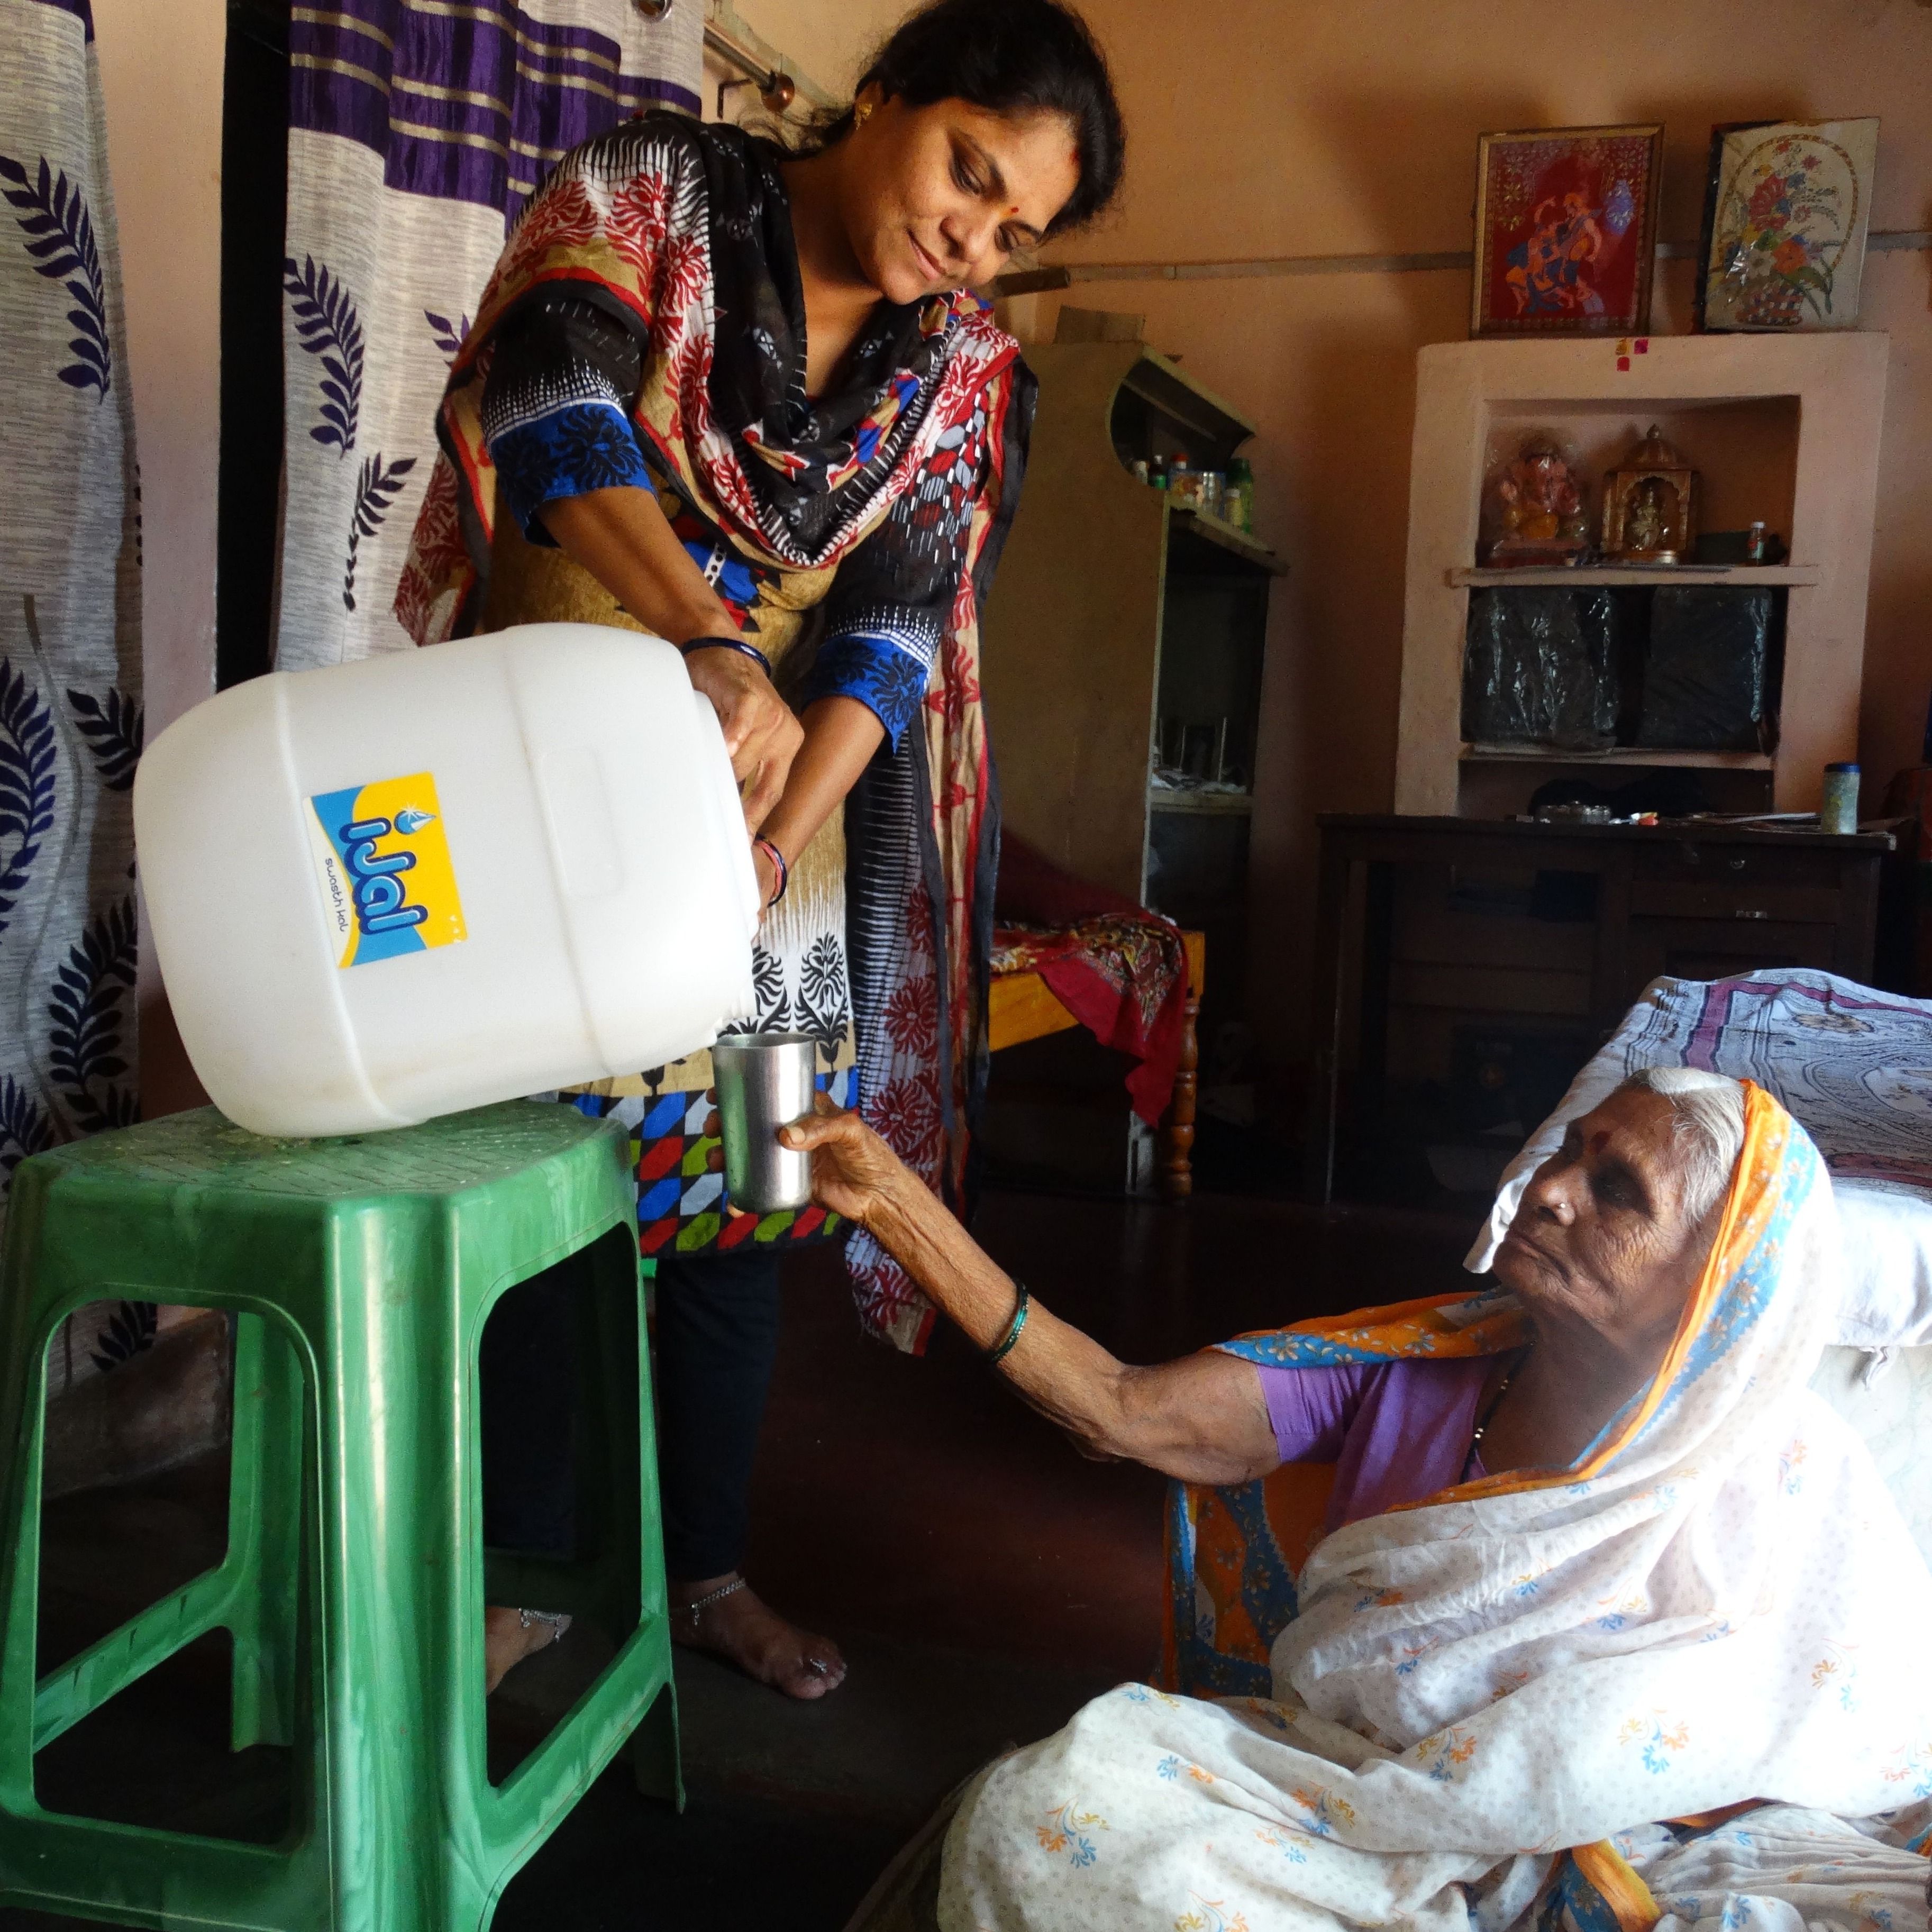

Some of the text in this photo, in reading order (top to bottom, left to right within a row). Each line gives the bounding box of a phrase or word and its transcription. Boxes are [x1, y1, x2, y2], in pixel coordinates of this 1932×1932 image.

[325, 858, 349, 932] swasth kal
[339, 809, 436, 935] iJal
